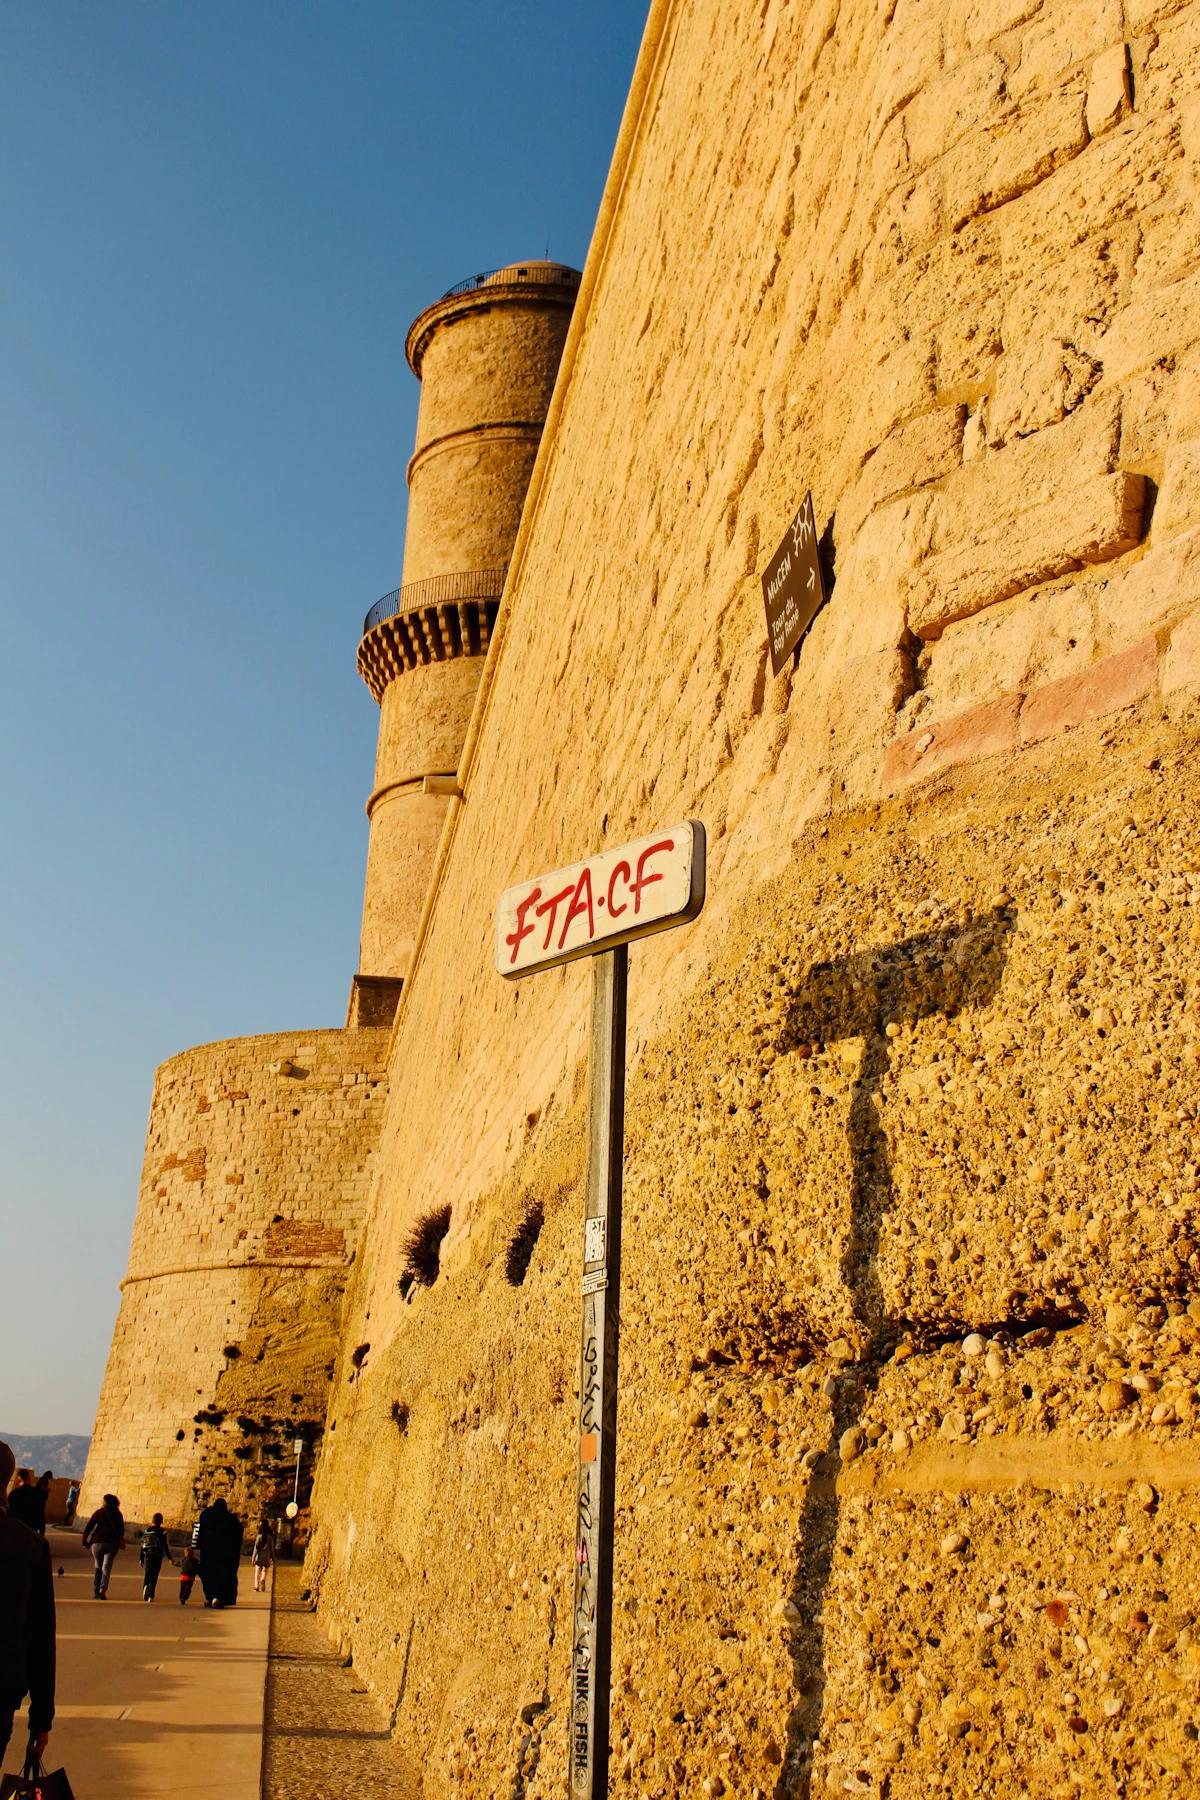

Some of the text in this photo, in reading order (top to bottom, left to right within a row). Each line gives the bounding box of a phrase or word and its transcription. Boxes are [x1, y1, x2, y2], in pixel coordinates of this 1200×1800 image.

[767, 552, 791, 604] MuCEM
[772, 596, 794, 636] Tour du
[773, 603, 799, 654] Roy René
[576, 1668, 589, 1700] INK
[575, 1723, 589, 1768] FISH
